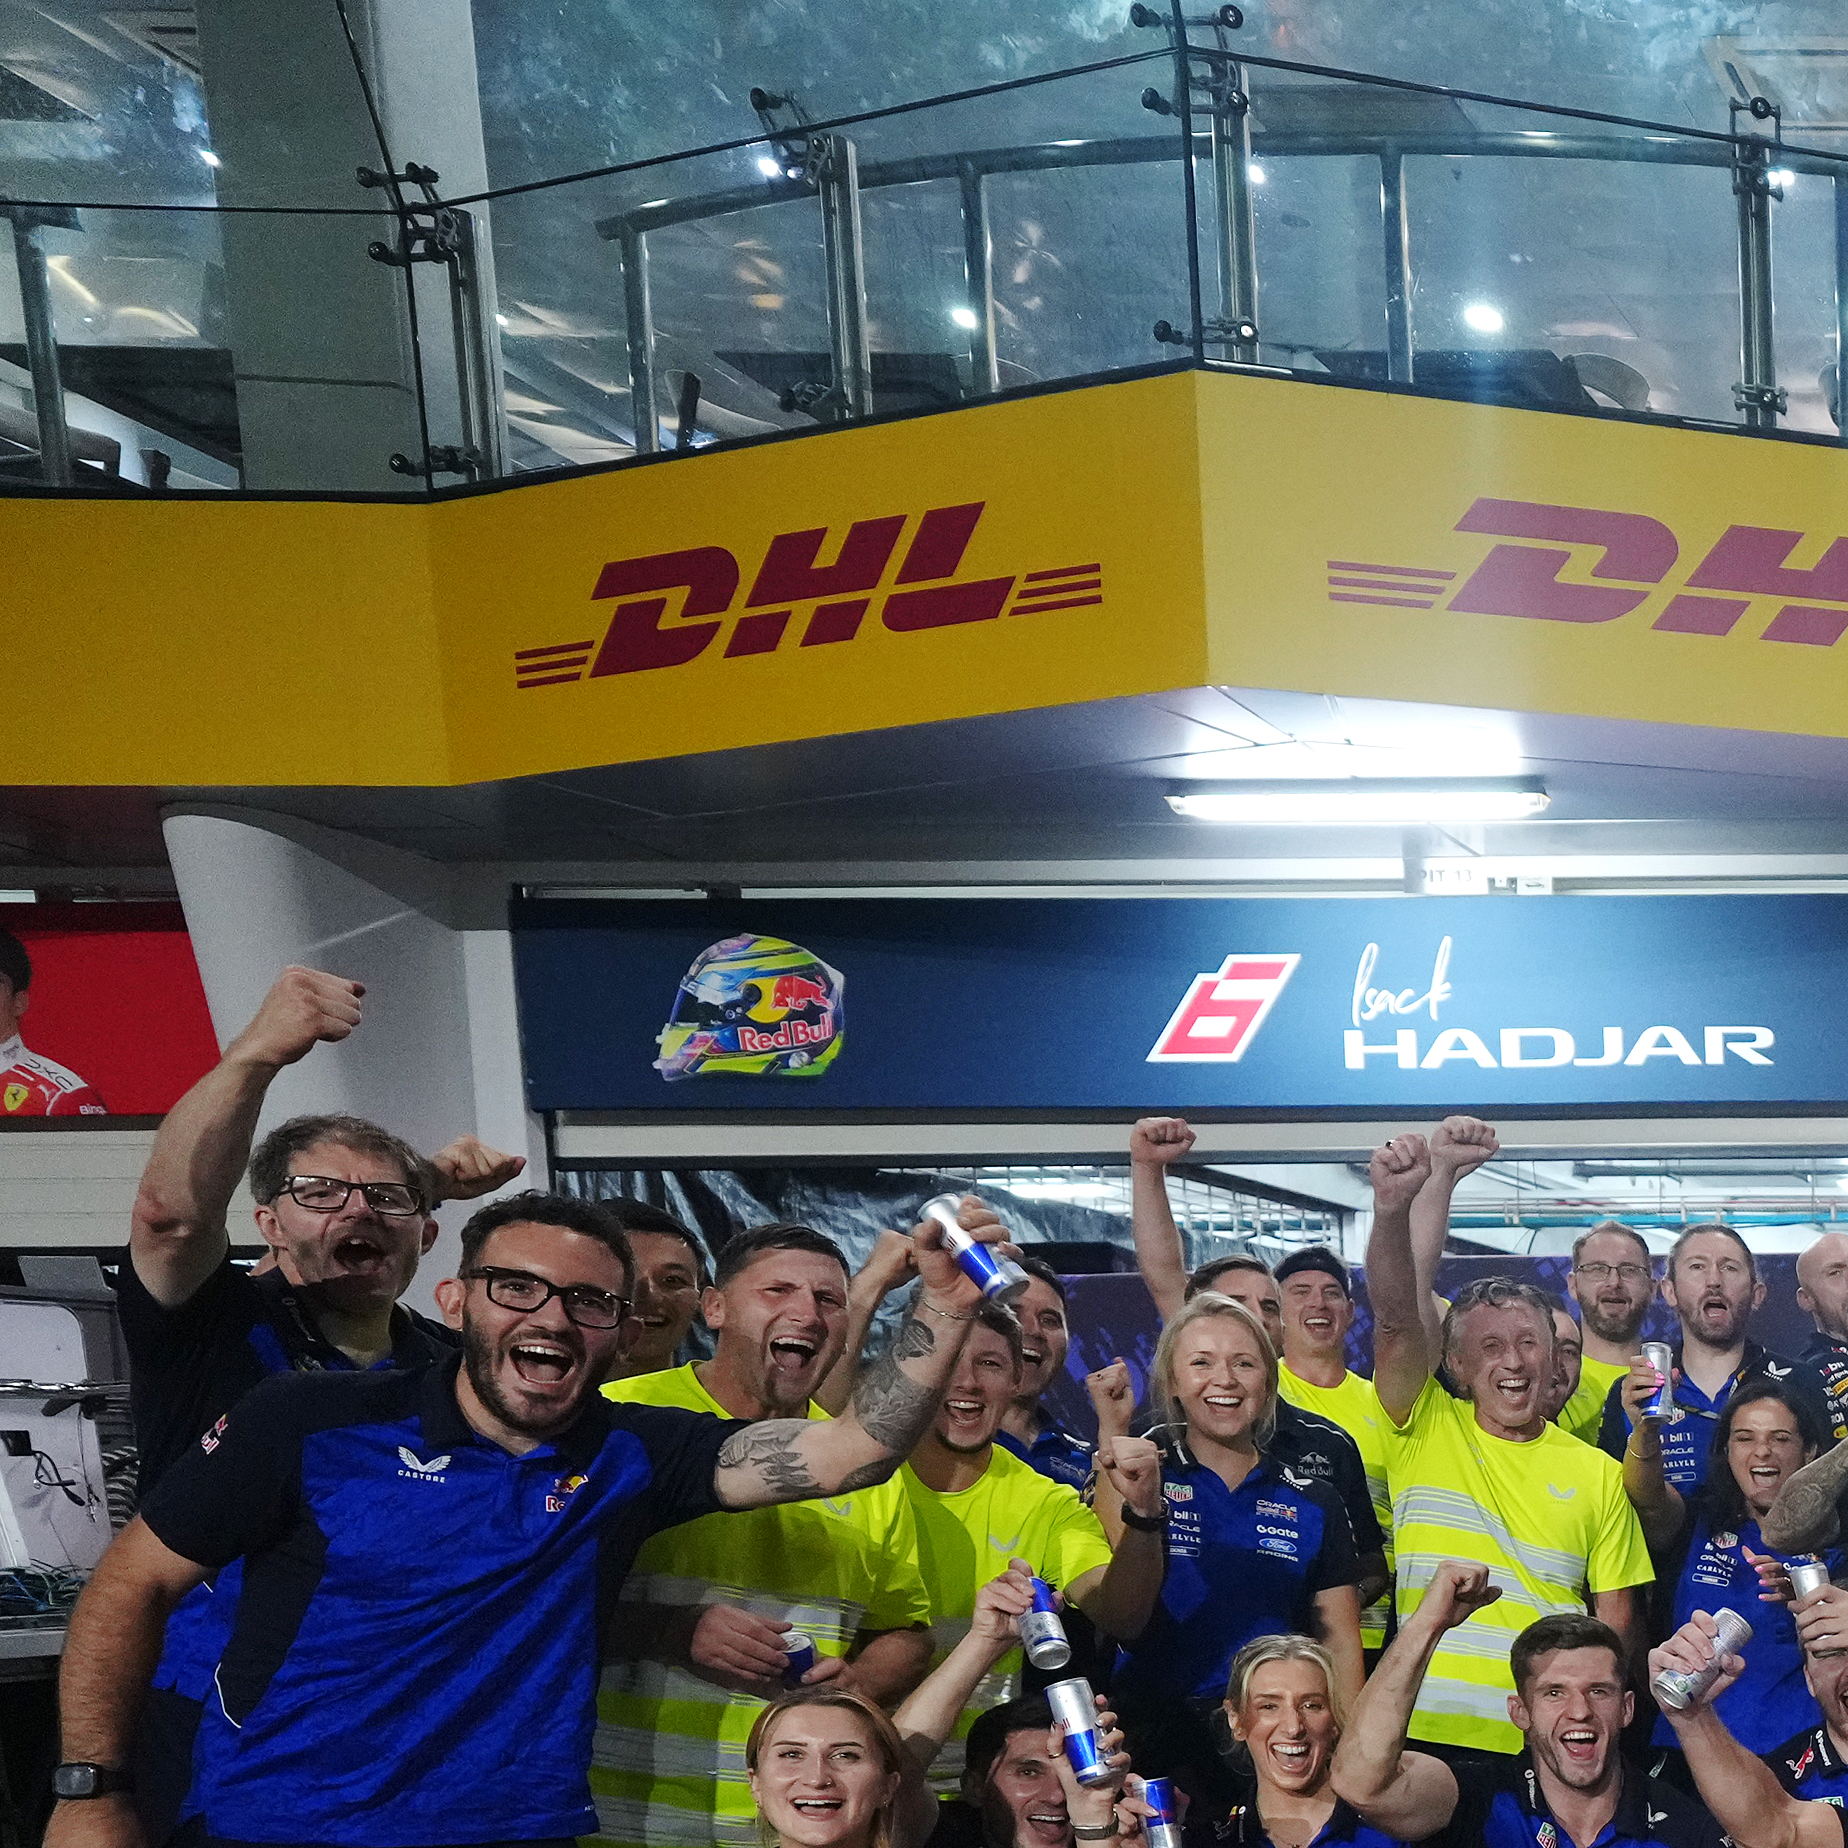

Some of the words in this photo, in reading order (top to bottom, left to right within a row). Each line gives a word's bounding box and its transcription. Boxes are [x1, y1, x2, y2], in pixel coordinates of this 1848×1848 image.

[590, 503, 1016, 679] DHL
[1351, 935, 1454, 1027] Isack
[739, 1021, 790, 1051] Red
[1343, 1025, 1776, 1070] HADJAR
[397, 1469, 447, 1484] CASTORE
[1269, 1526, 1299, 1540] Gate
